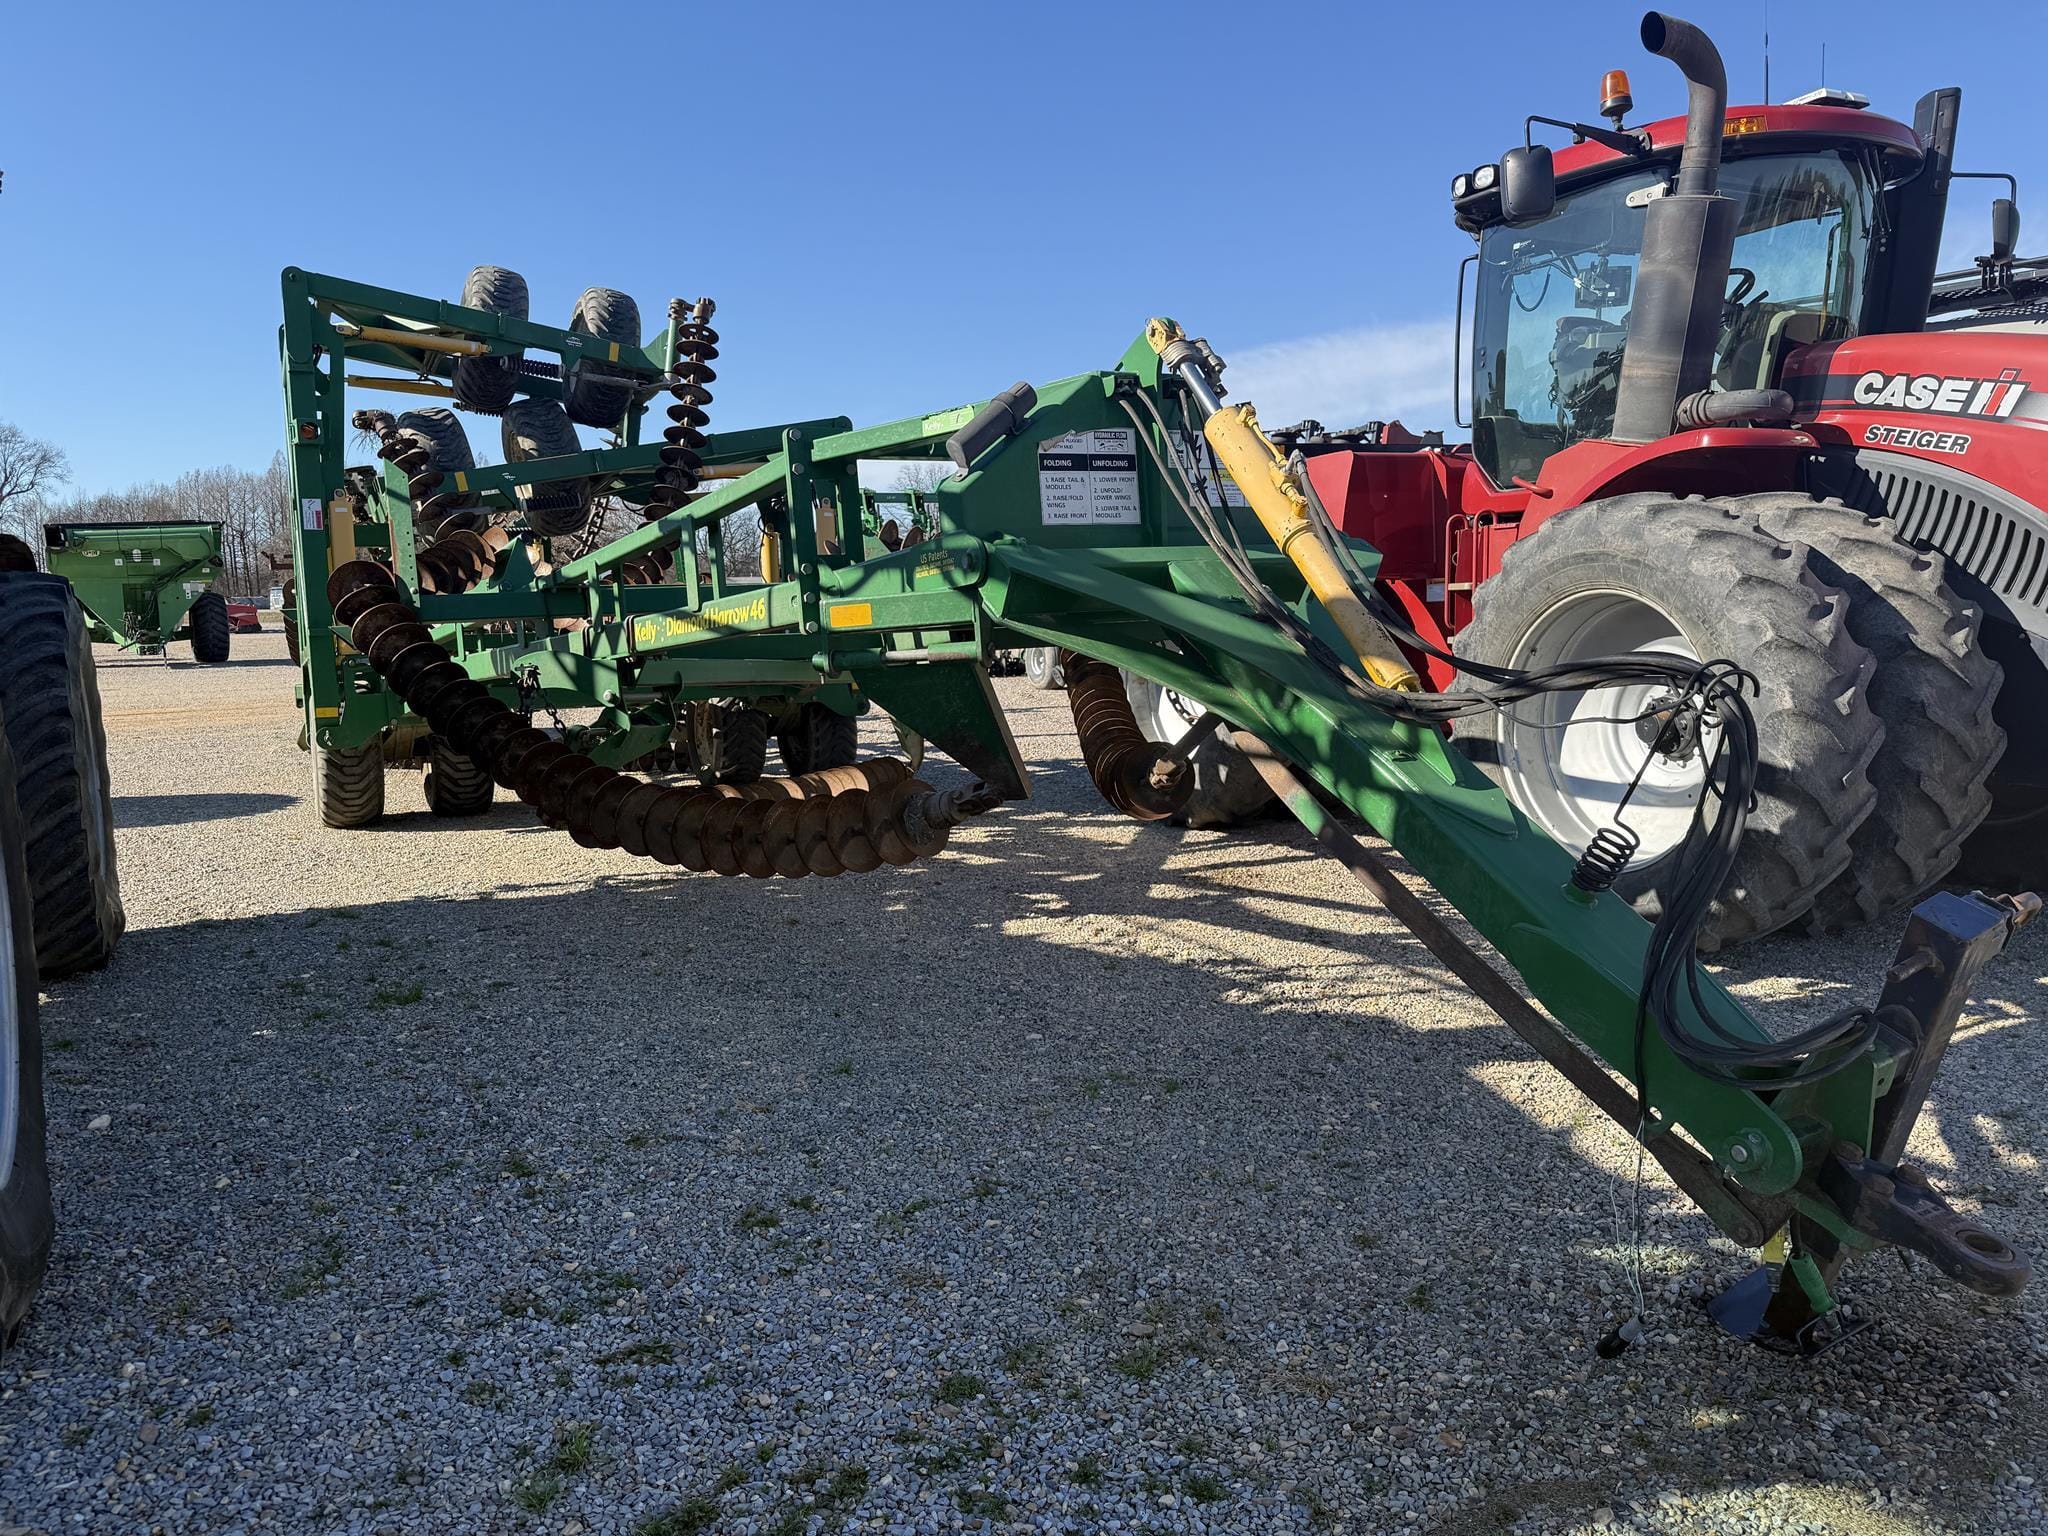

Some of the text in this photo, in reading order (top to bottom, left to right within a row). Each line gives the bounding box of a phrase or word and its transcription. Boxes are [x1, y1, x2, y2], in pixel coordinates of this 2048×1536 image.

[1854, 370, 2026, 418] CASE IH
[1865, 425, 1971, 454] STEIGER
[1043, 459, 1072, 467] FOLDING
[920, 550, 948, 564] US Patents
[634, 597, 766, 645] Kelly Diamond Harrow 46
